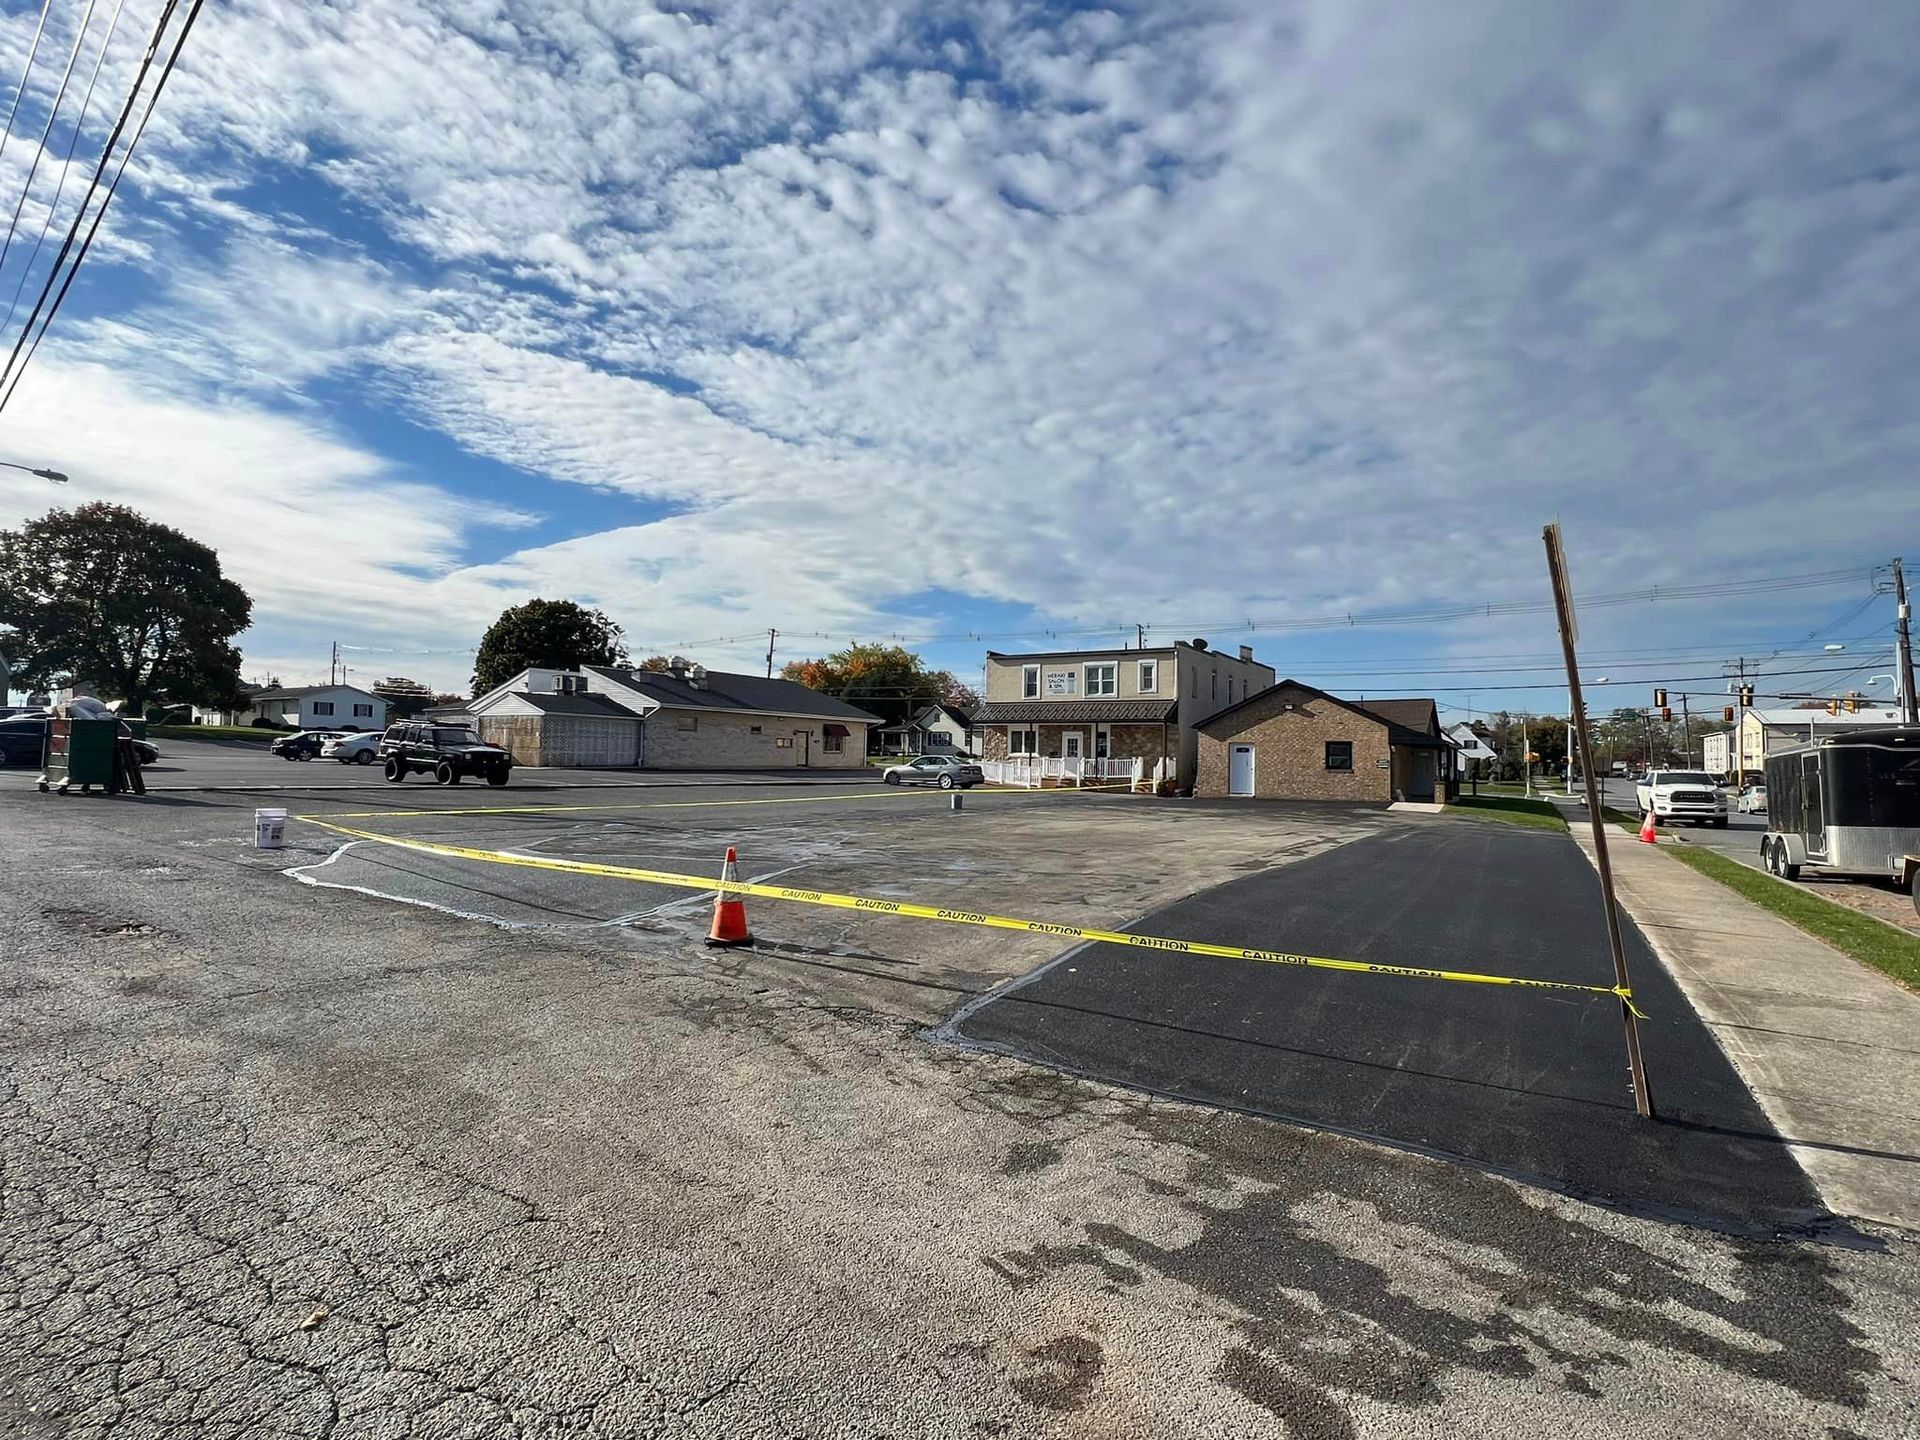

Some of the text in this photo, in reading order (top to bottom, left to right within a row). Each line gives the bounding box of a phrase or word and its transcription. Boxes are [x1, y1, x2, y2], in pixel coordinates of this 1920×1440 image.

[715, 881, 752, 892] CAUTION
[781, 889, 822, 901] CAUTION
[855, 899, 900, 912] CAUTION
[937, 910, 986, 923] CAUTION
[1028, 922, 1082, 936] CAUTION
[1129, 936, 1189, 951] CAUTION
[1242, 950, 1308, 965] CAUTION
